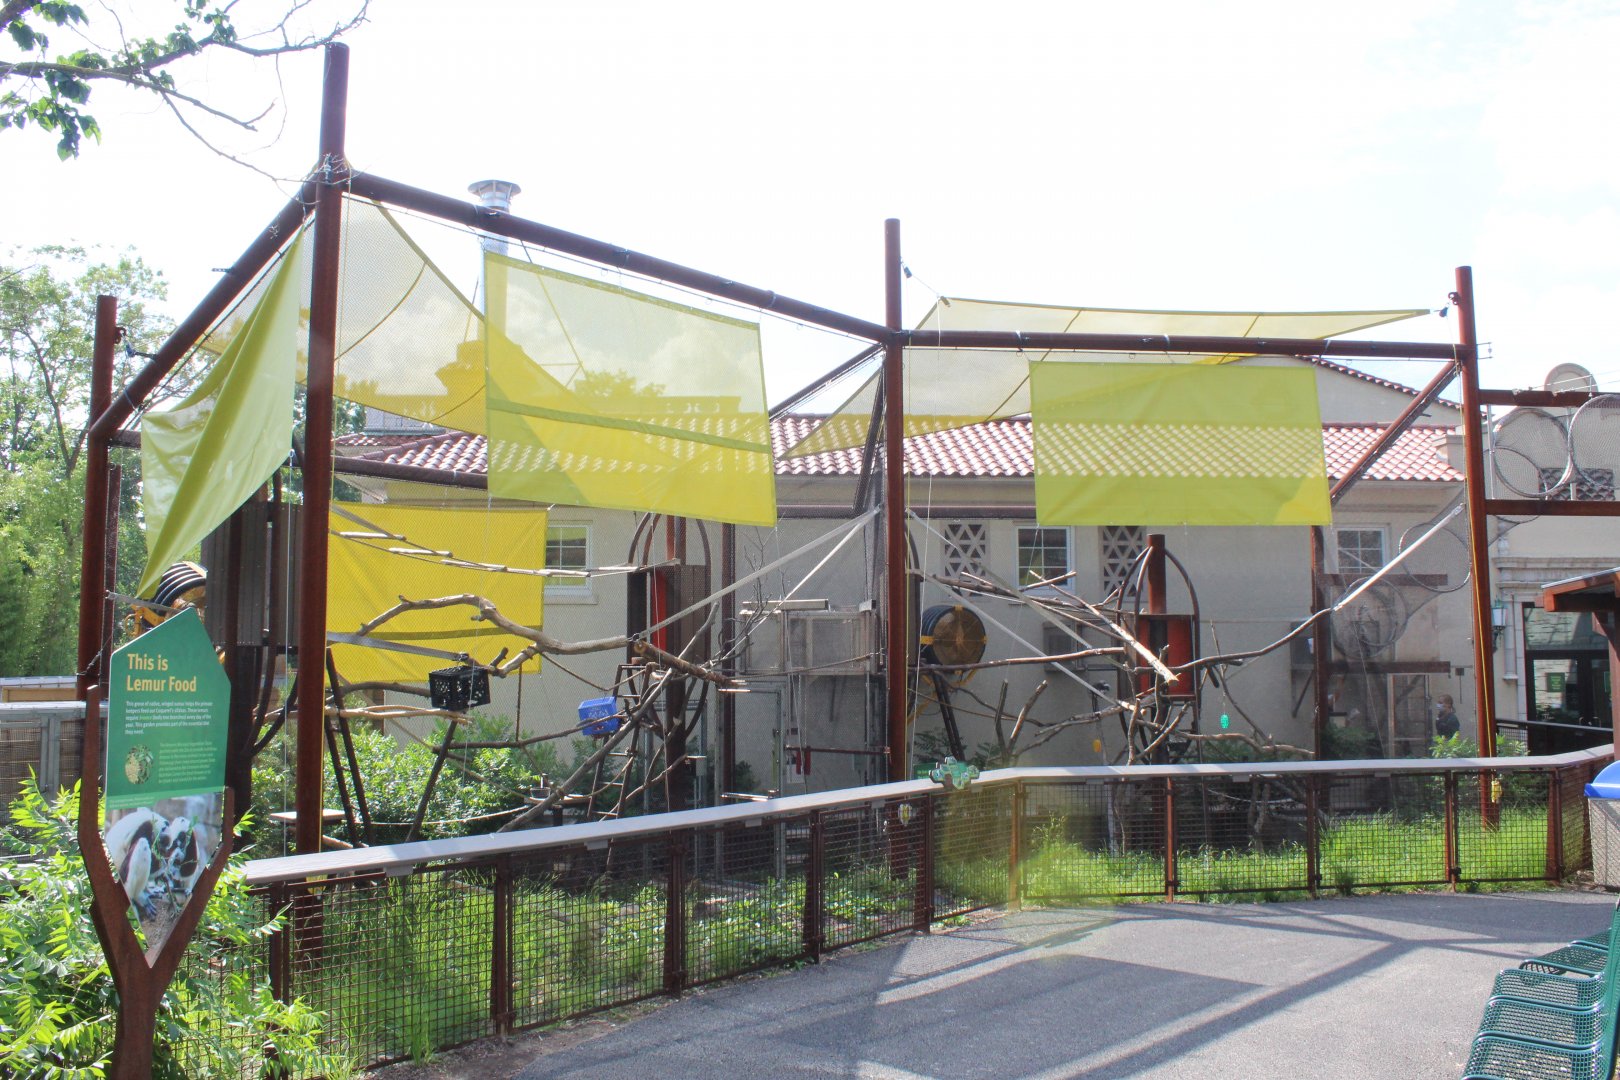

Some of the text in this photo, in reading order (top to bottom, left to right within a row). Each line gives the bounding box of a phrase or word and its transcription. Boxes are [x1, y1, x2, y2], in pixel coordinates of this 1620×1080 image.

[127, 653, 168, 671] This is
[127, 675, 197, 692] Lemur Food
